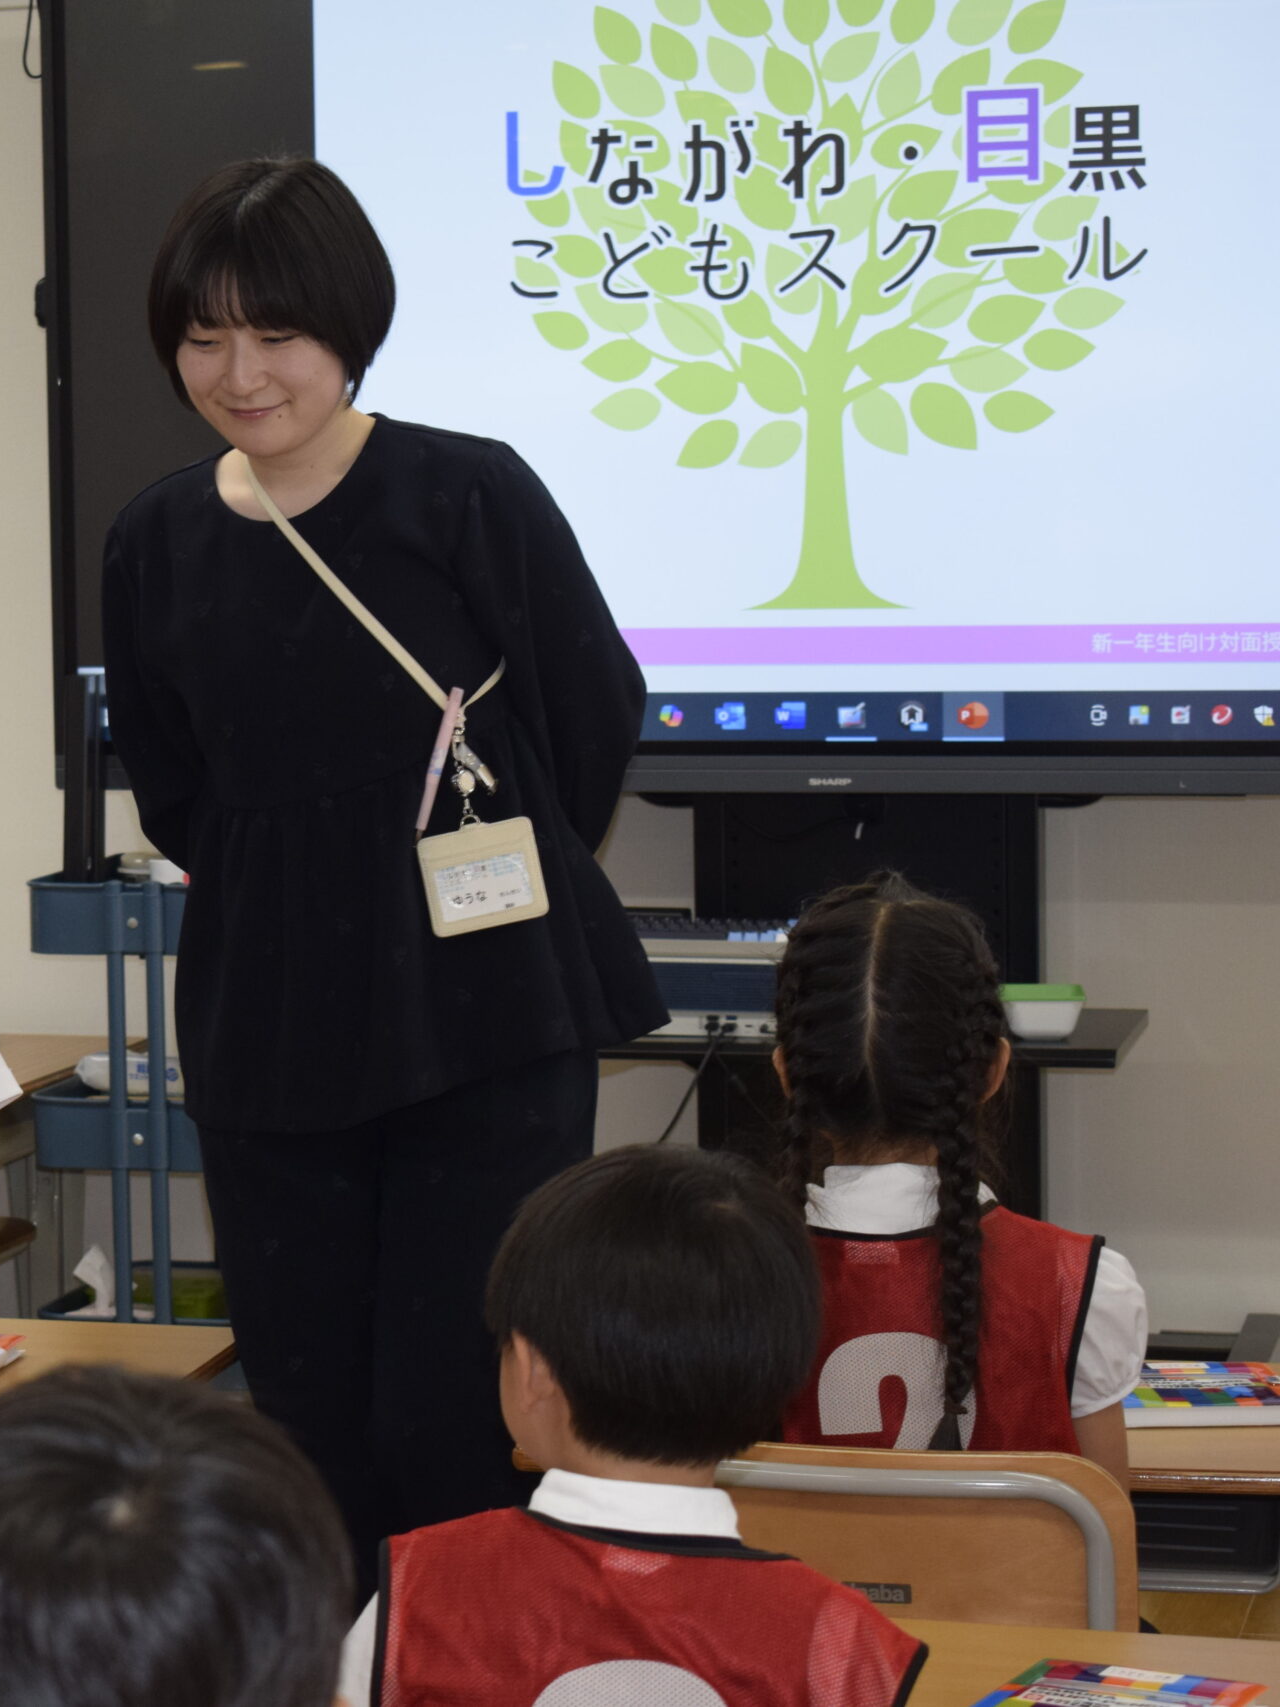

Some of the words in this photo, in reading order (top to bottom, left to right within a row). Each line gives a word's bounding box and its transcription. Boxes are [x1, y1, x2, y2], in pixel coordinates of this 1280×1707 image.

[505, 86, 1148, 205] しながわ・目黒
[509, 215, 1149, 301] こどもスクール
[809, 777, 852, 787] SHARP
